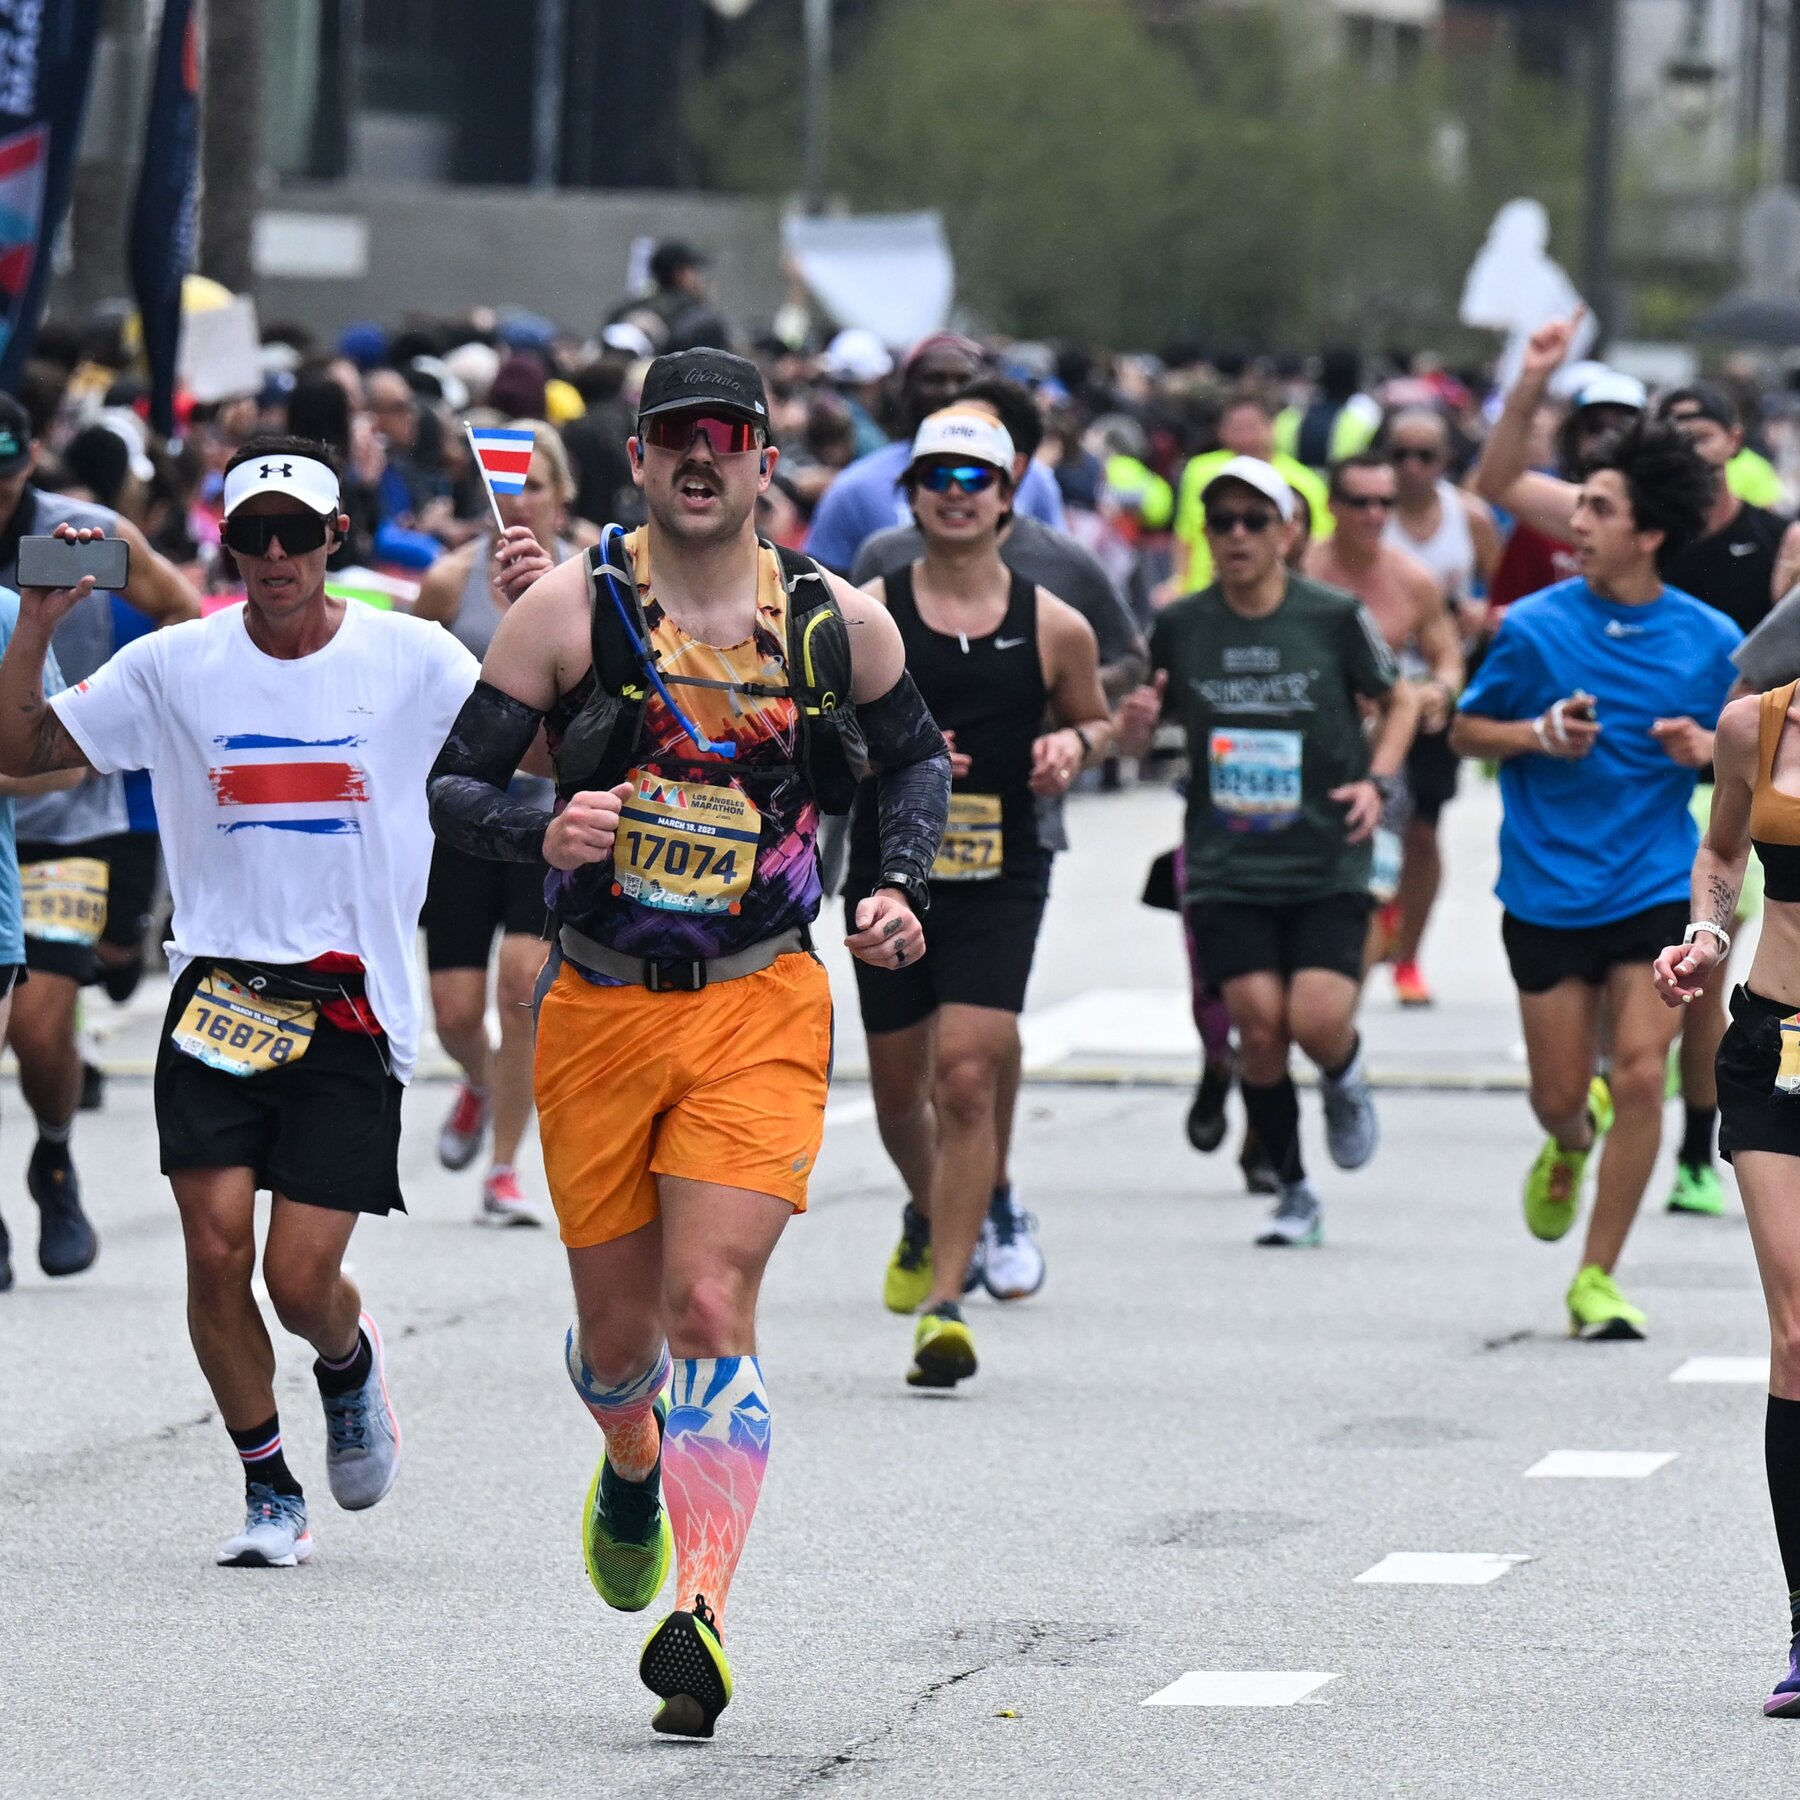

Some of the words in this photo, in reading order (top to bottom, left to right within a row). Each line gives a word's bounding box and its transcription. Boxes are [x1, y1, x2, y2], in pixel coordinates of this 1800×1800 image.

[664, 367, 741, 391] California
[691, 800, 745, 816] MARATHON
[692, 793, 707, 801] LOS
[709, 796, 745, 808] ANGELES
[658, 816, 686, 830] MARCH
[686, 823, 697, 833] 19,
[697, 825, 716, 835] 2023
[627, 831, 737, 885] 17074
[663, 893, 695, 906] asics
[229, 1003, 253, 1016] MARCH
[195, 1007, 294, 1065] 16878
